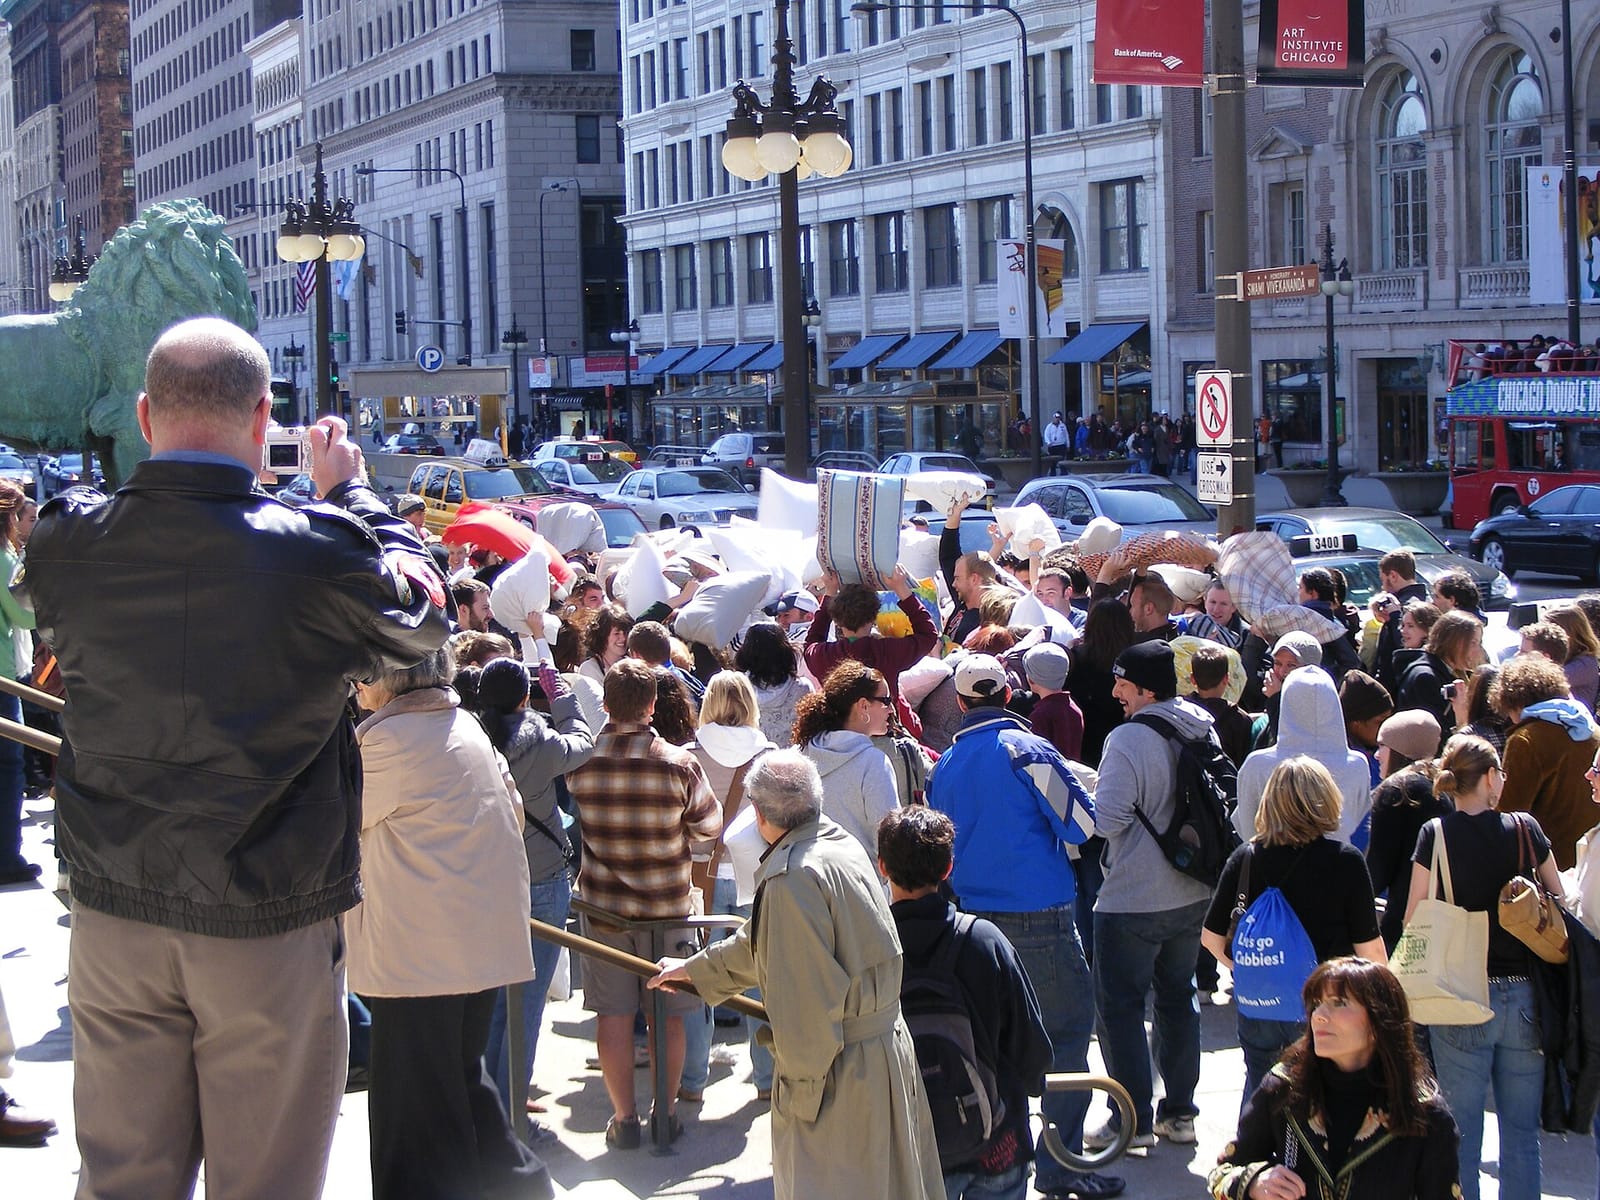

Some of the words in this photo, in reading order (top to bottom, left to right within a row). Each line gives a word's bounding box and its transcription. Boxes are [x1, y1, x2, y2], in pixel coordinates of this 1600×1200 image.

[1282, 28, 1305, 38] ART
[1282, 40, 1343, 51] INSTITVTE
[1114, 48, 1130, 57] Bank
[1130, 49, 1137, 57] of
[1137, 49, 1163, 58] America
[1281, 52, 1336, 63] CHICAGO
[1270, 271, 1291, 279] HONORARY
[1247, 281, 1265, 297] SWAMI
[1266, 277, 1306, 295] VIVEKANANDA
[425, 350, 440, 369] P
[1497, 381, 1544, 412] CHICAGO
[1546, 379, 1587, 413] DOUBLE
[1201, 460, 1214, 475] USE
[1199, 480, 1231, 495] CROSSWALK
[1315, 536, 1340, 550] 3400
[1256, 936, 1274, 952] go
